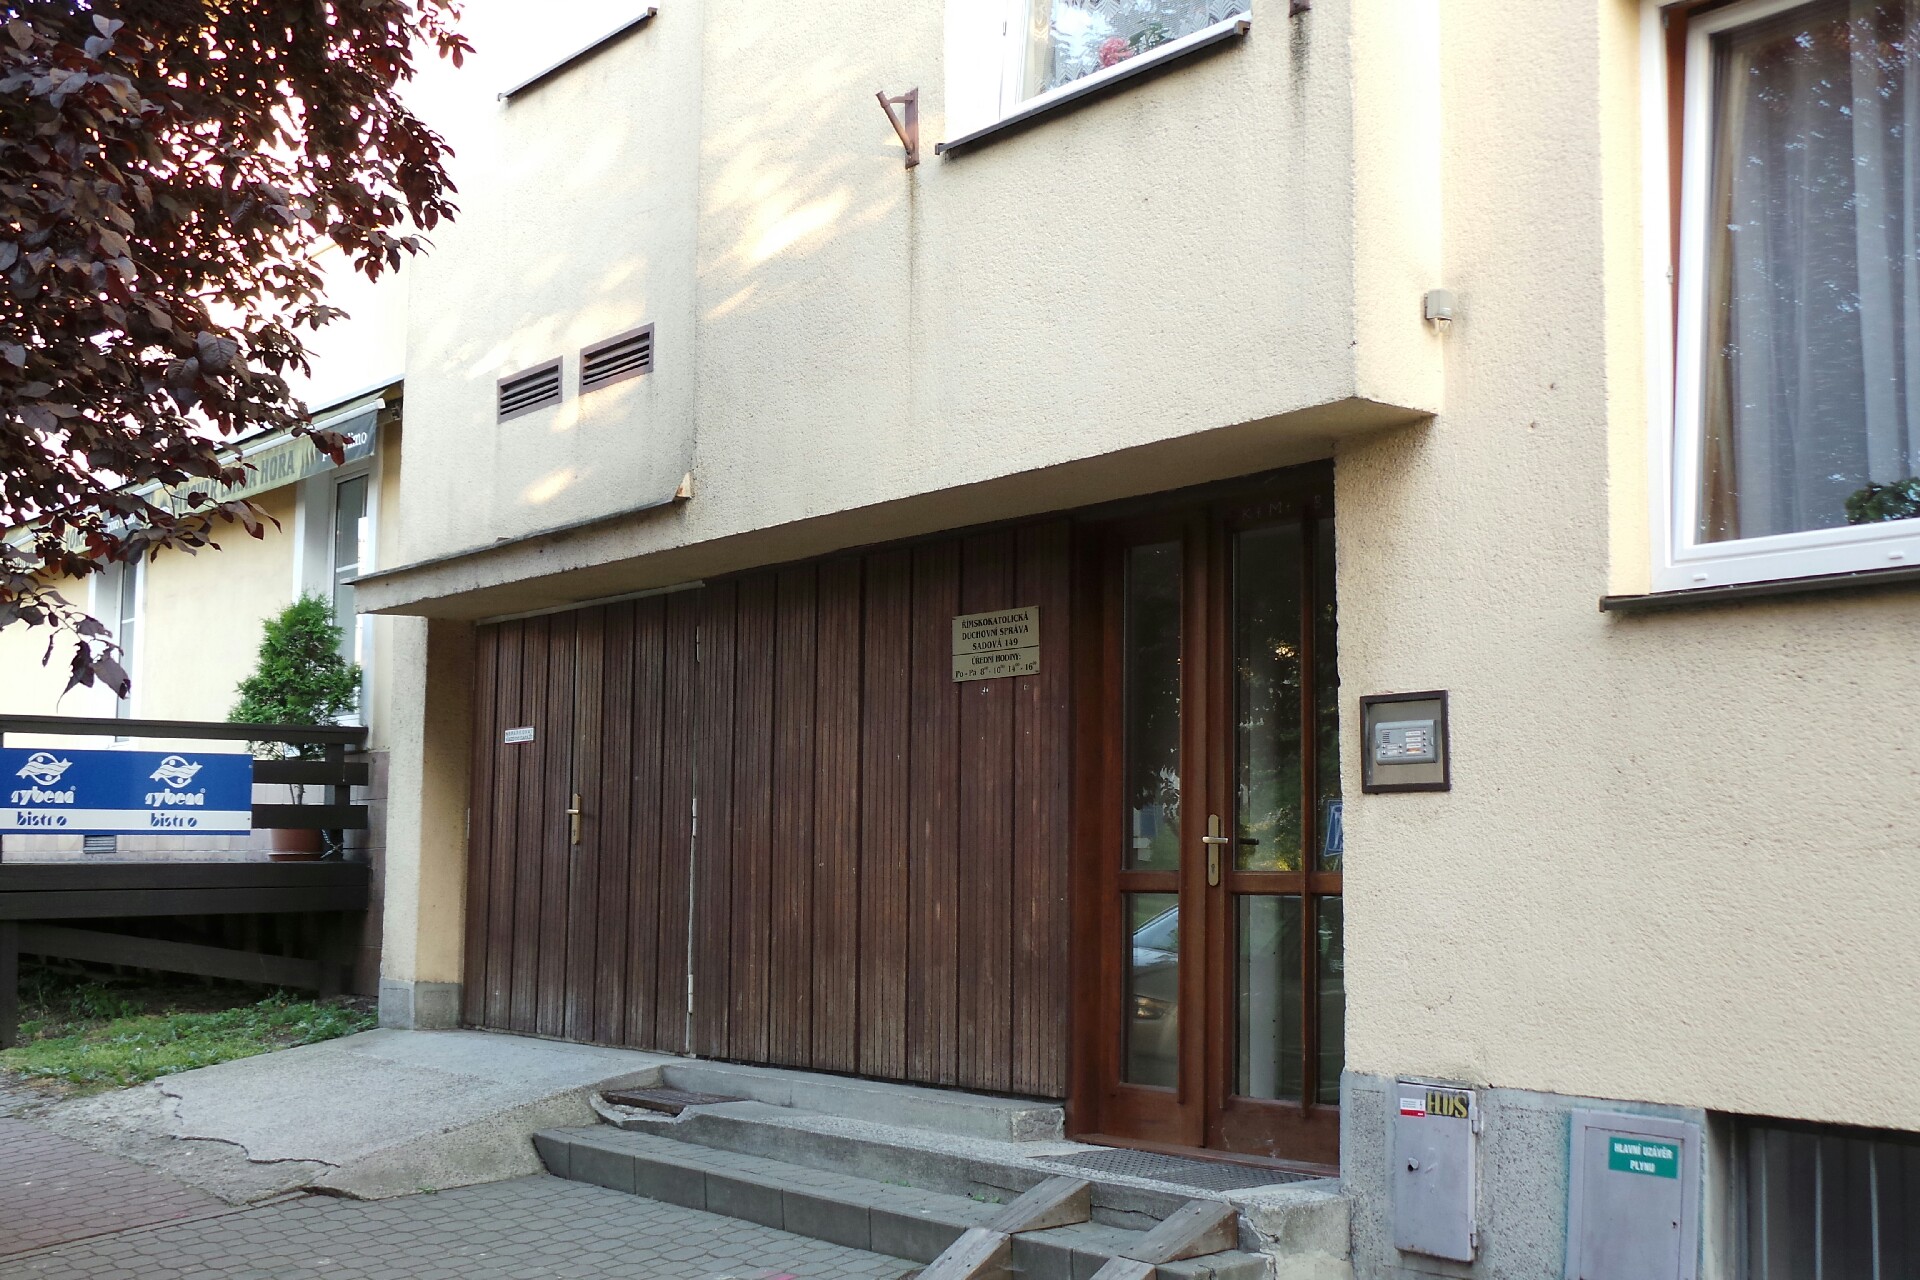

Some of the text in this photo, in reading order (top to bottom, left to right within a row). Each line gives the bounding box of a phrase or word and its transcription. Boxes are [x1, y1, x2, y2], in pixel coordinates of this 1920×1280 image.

[261, 451, 295, 484] HORA
[961, 611, 1029, 629] ŘÍMSKOKATOLICKÁ
[962, 625, 1029, 640] DUCHOVNÍ SPRÁVA
[972, 637, 1019, 651] SADOVÁ 149
[971, 653, 995, 665] ÚŘEDNÍ
[17, 811, 67, 827] bistro
[150, 813, 198, 828] bistro
[1426, 1090, 1469, 1119] HDS
[1614, 1142, 1674, 1159] HLAVNÍ UZÁVĚR
[1630, 1160, 1656, 1173] PLYNU
